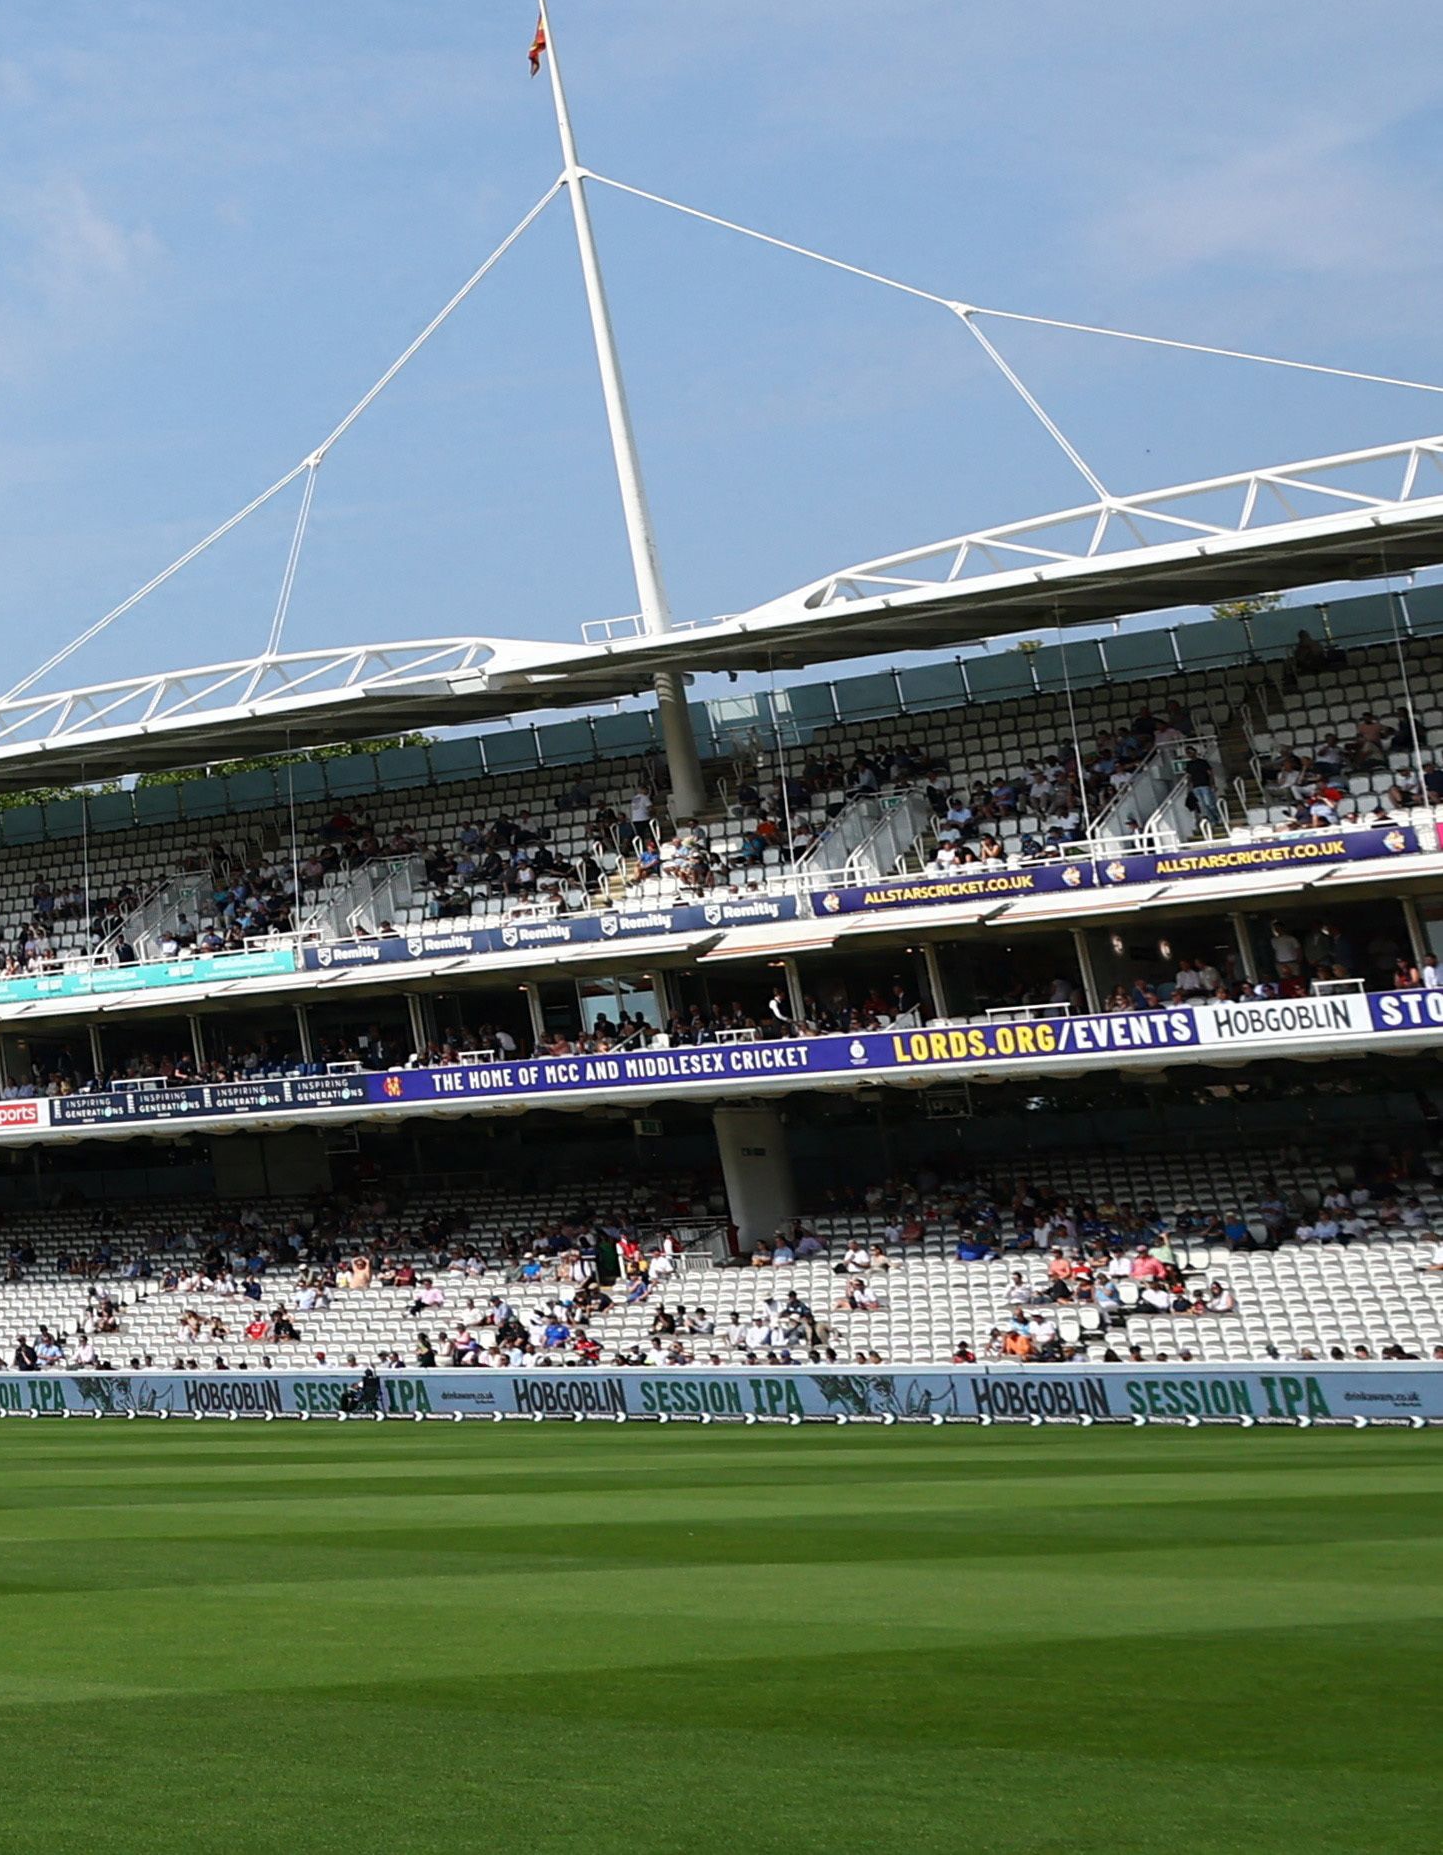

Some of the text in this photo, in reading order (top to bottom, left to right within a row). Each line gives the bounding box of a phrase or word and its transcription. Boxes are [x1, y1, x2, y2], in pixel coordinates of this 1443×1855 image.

[1156, 840, 1345, 874] ALLSTARSCRICKET.CO.UK
[864, 875, 1034, 905] ALLSTARSCRICKET.CO.UK
[621, 913, 672, 930] Remitly
[723, 903, 777, 919] Remitly
[425, 936, 472, 952] Remitly
[520, 925, 570, 941] Remitly
[334, 945, 380, 961] Remitly
[1213, 999, 1351, 1038] HOBGOBLIN
[892, 1012, 1192, 1062] LORDS.ORG/EVENTS
[432, 1046, 809, 1092] THE HOME OF MCC AND MIDDLESEX CRICKET
[216, 1085, 266, 1097] INSPIRING
[297, 1078, 349, 1091] INSPIRING
[66, 1098, 111, 1108] INSPIRING
[140, 1091, 187, 1103] INSPIRING
[28, 1380, 66, 1411] IPA
[184, 1380, 283, 1413] HOBGOBLIN
[385, 1379, 432, 1412] IPA
[512, 1378, 805, 1416] HOBGOBLIN SESSION IPA
[971, 1378, 1111, 1415] HOBGOBLIN
[1126, 1380, 1253, 1416] SESSION
[1260, 1376, 1332, 1417] IPA
